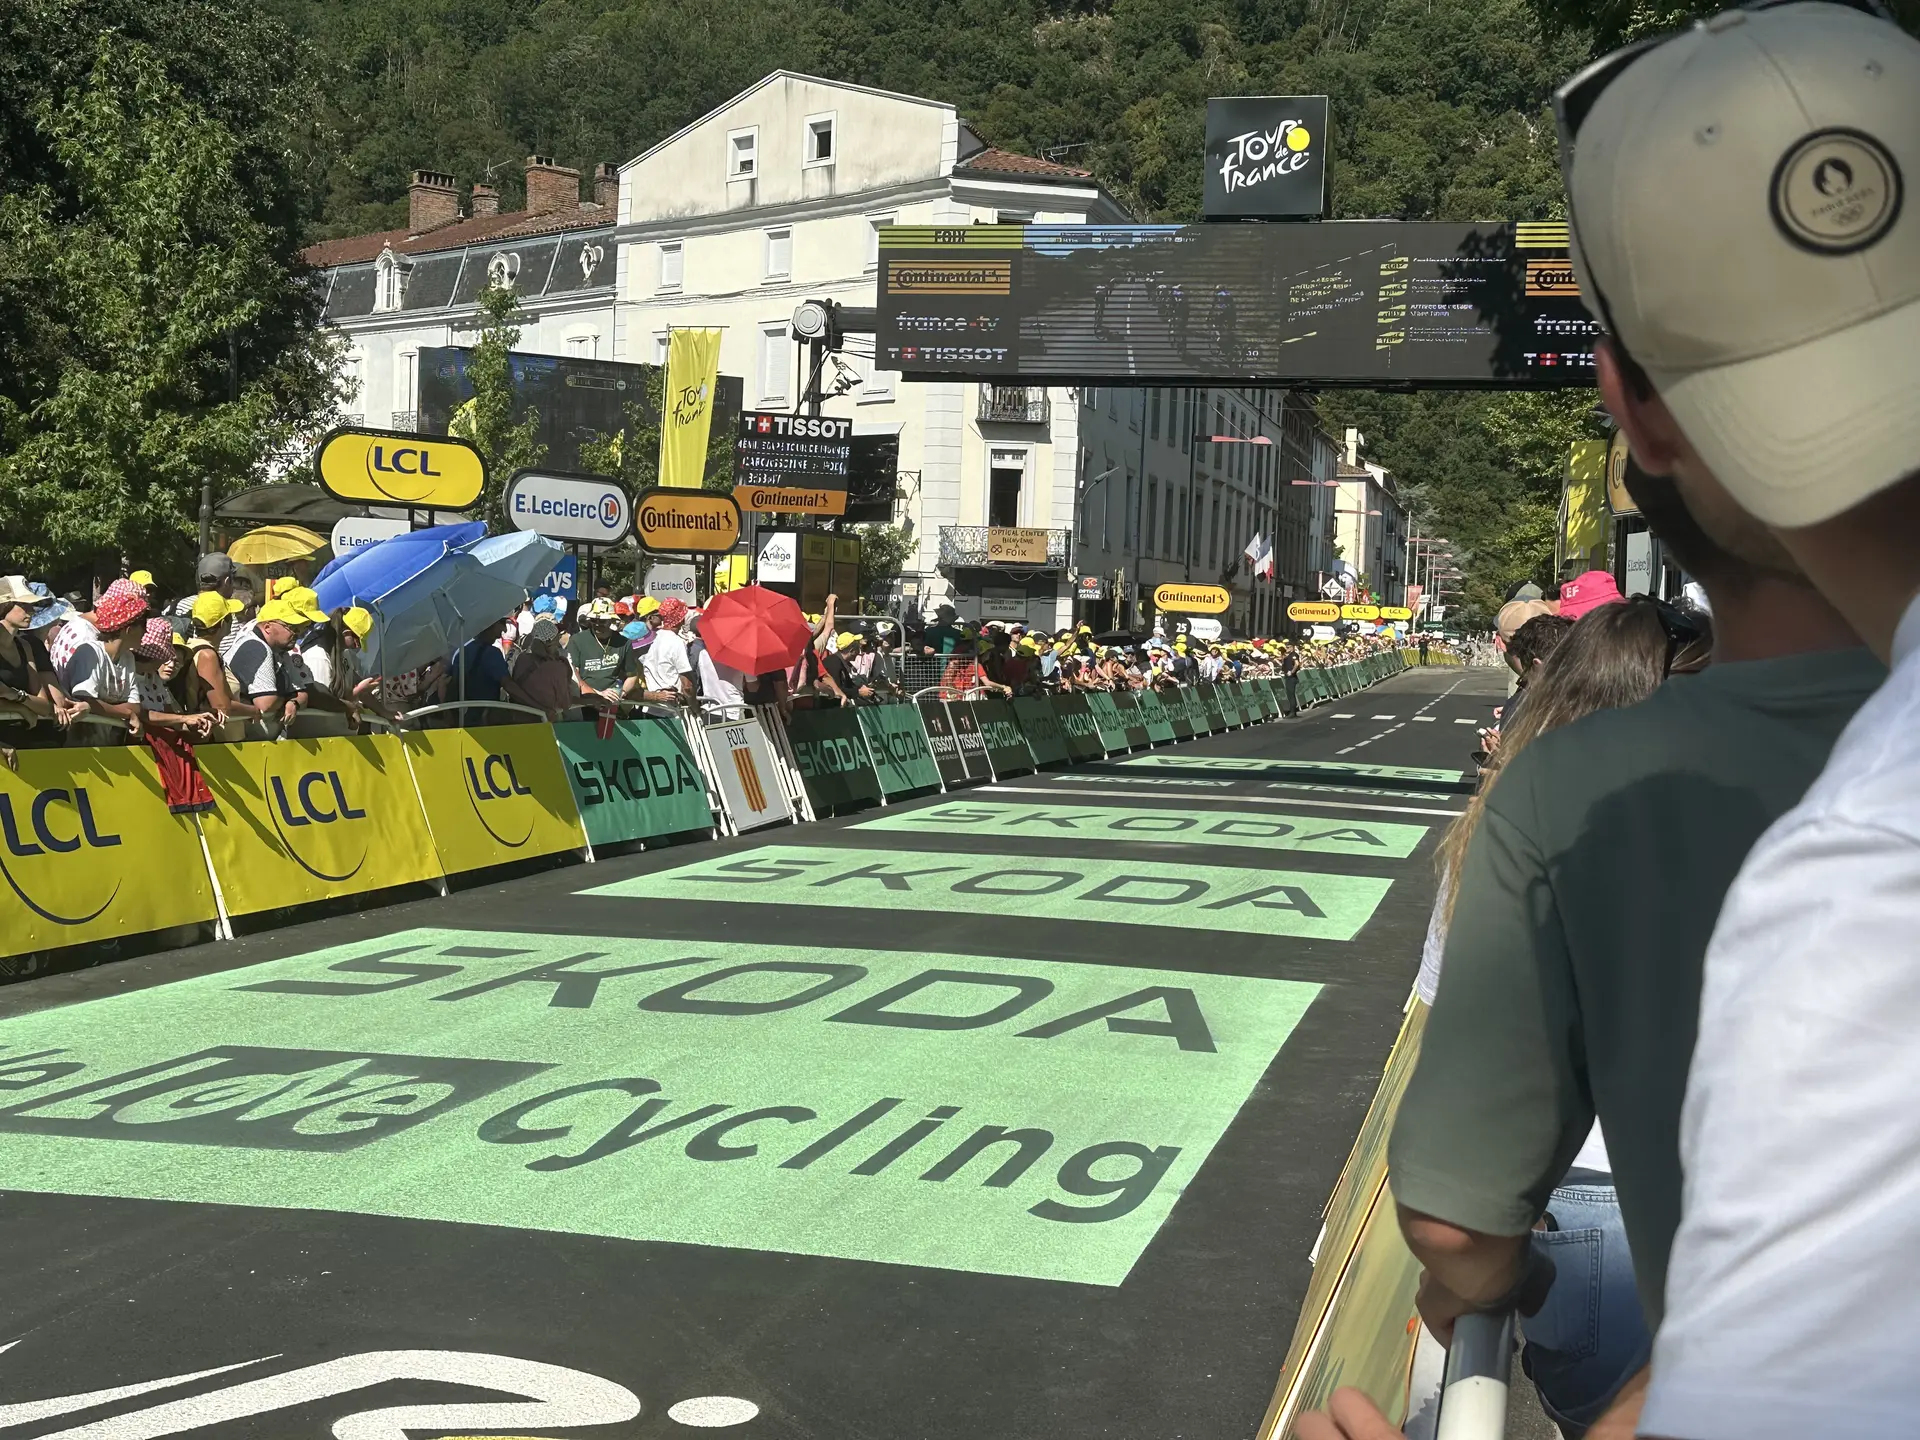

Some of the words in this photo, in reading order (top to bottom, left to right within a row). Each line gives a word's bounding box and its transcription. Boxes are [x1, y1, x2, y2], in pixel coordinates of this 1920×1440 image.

[896, 268, 986, 288] Continental
[1534, 313, 1602, 335] franc
[920, 348, 1008, 363] TISSOT
[774, 416, 850, 439] TISSOT
[374, 446, 442, 477] LCL
[515, 494, 597, 520] E.Leclerc
[751, 490, 819, 508] Continental
[641, 506, 722, 533] Continental
[1005, 548, 1027, 557] FOIX
[540, 571, 572, 593] rys
[1565, 585, 1580, 599] EF
[1158, 590, 1216, 604] Continental
[1175, 622, 1188, 633] 25
[725, 727, 748, 748] FOIX
[465, 753, 532, 801] LCL
[271, 770, 366, 827] LCL
[0, 787, 122, 857] LCL
